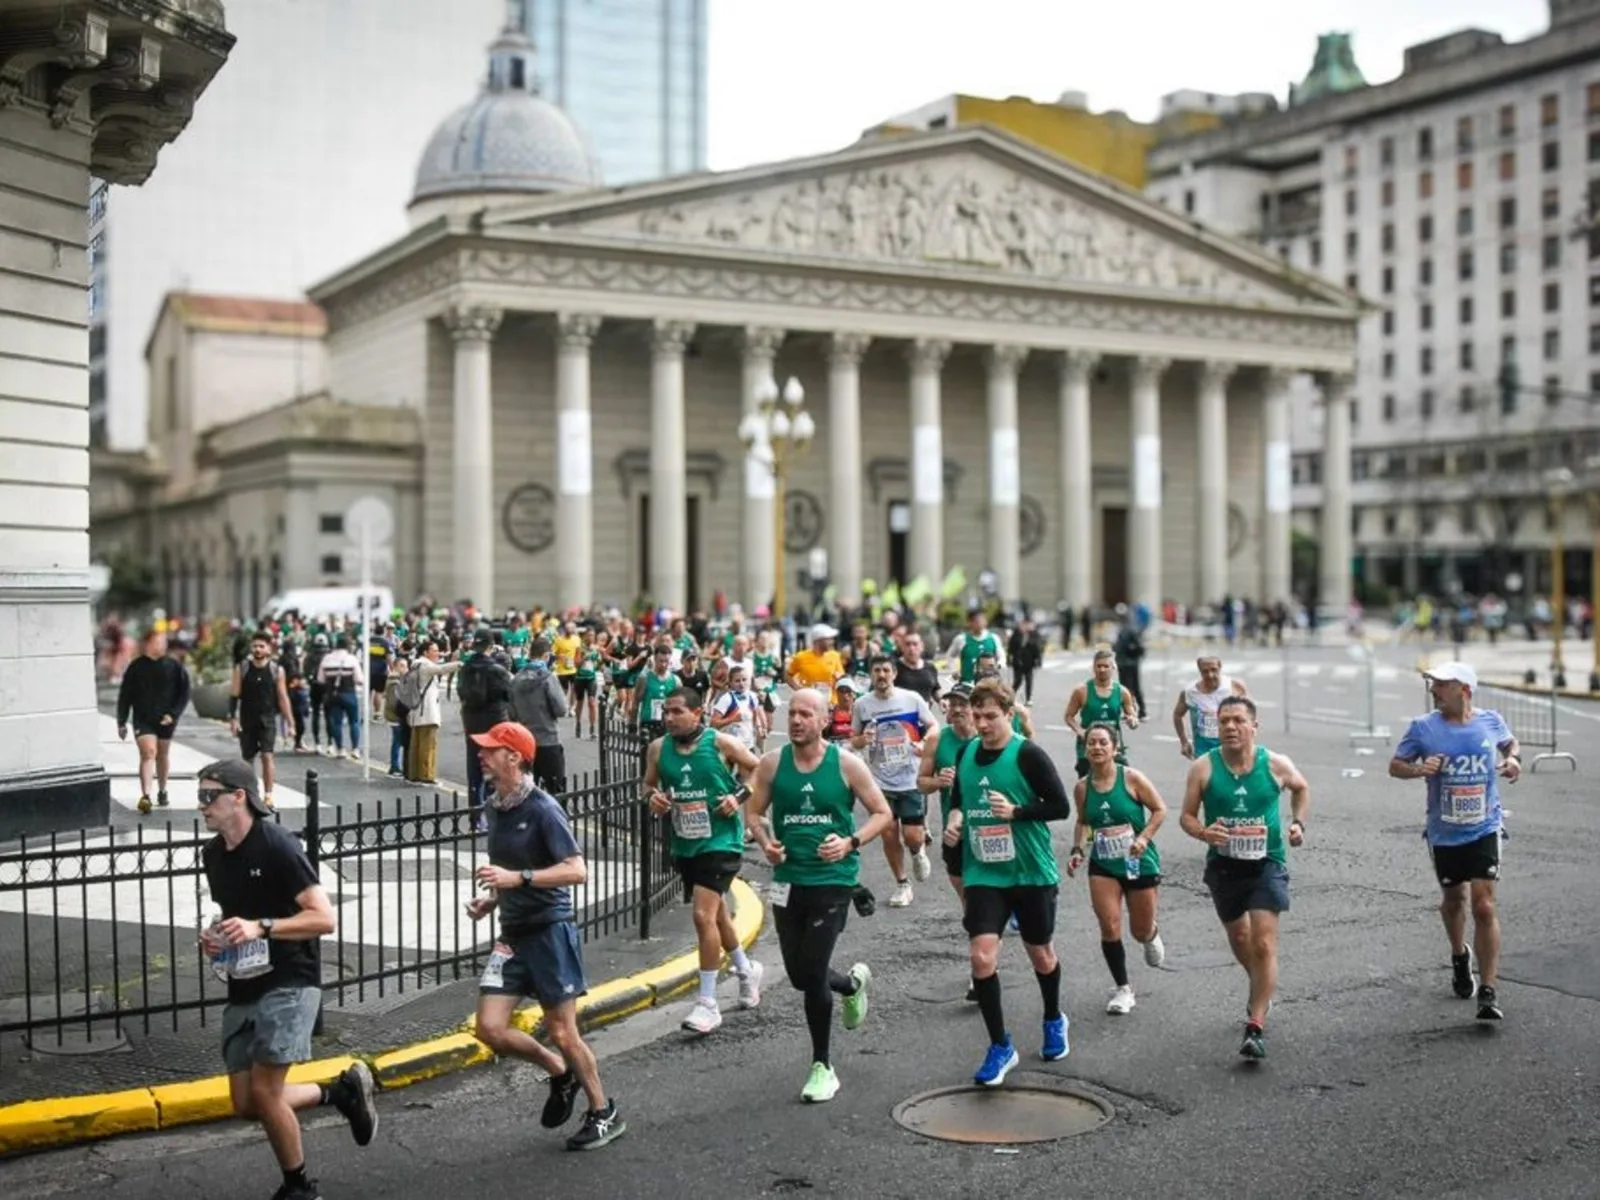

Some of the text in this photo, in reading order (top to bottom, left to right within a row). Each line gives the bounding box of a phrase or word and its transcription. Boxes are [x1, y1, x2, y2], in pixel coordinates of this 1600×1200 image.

[1441, 754, 1488, 775] 42K
[671, 788, 708, 799] ersonal
[784, 813, 833, 826] personal
[967, 809, 993, 819] perso
[982, 838, 1009, 853] 6897
